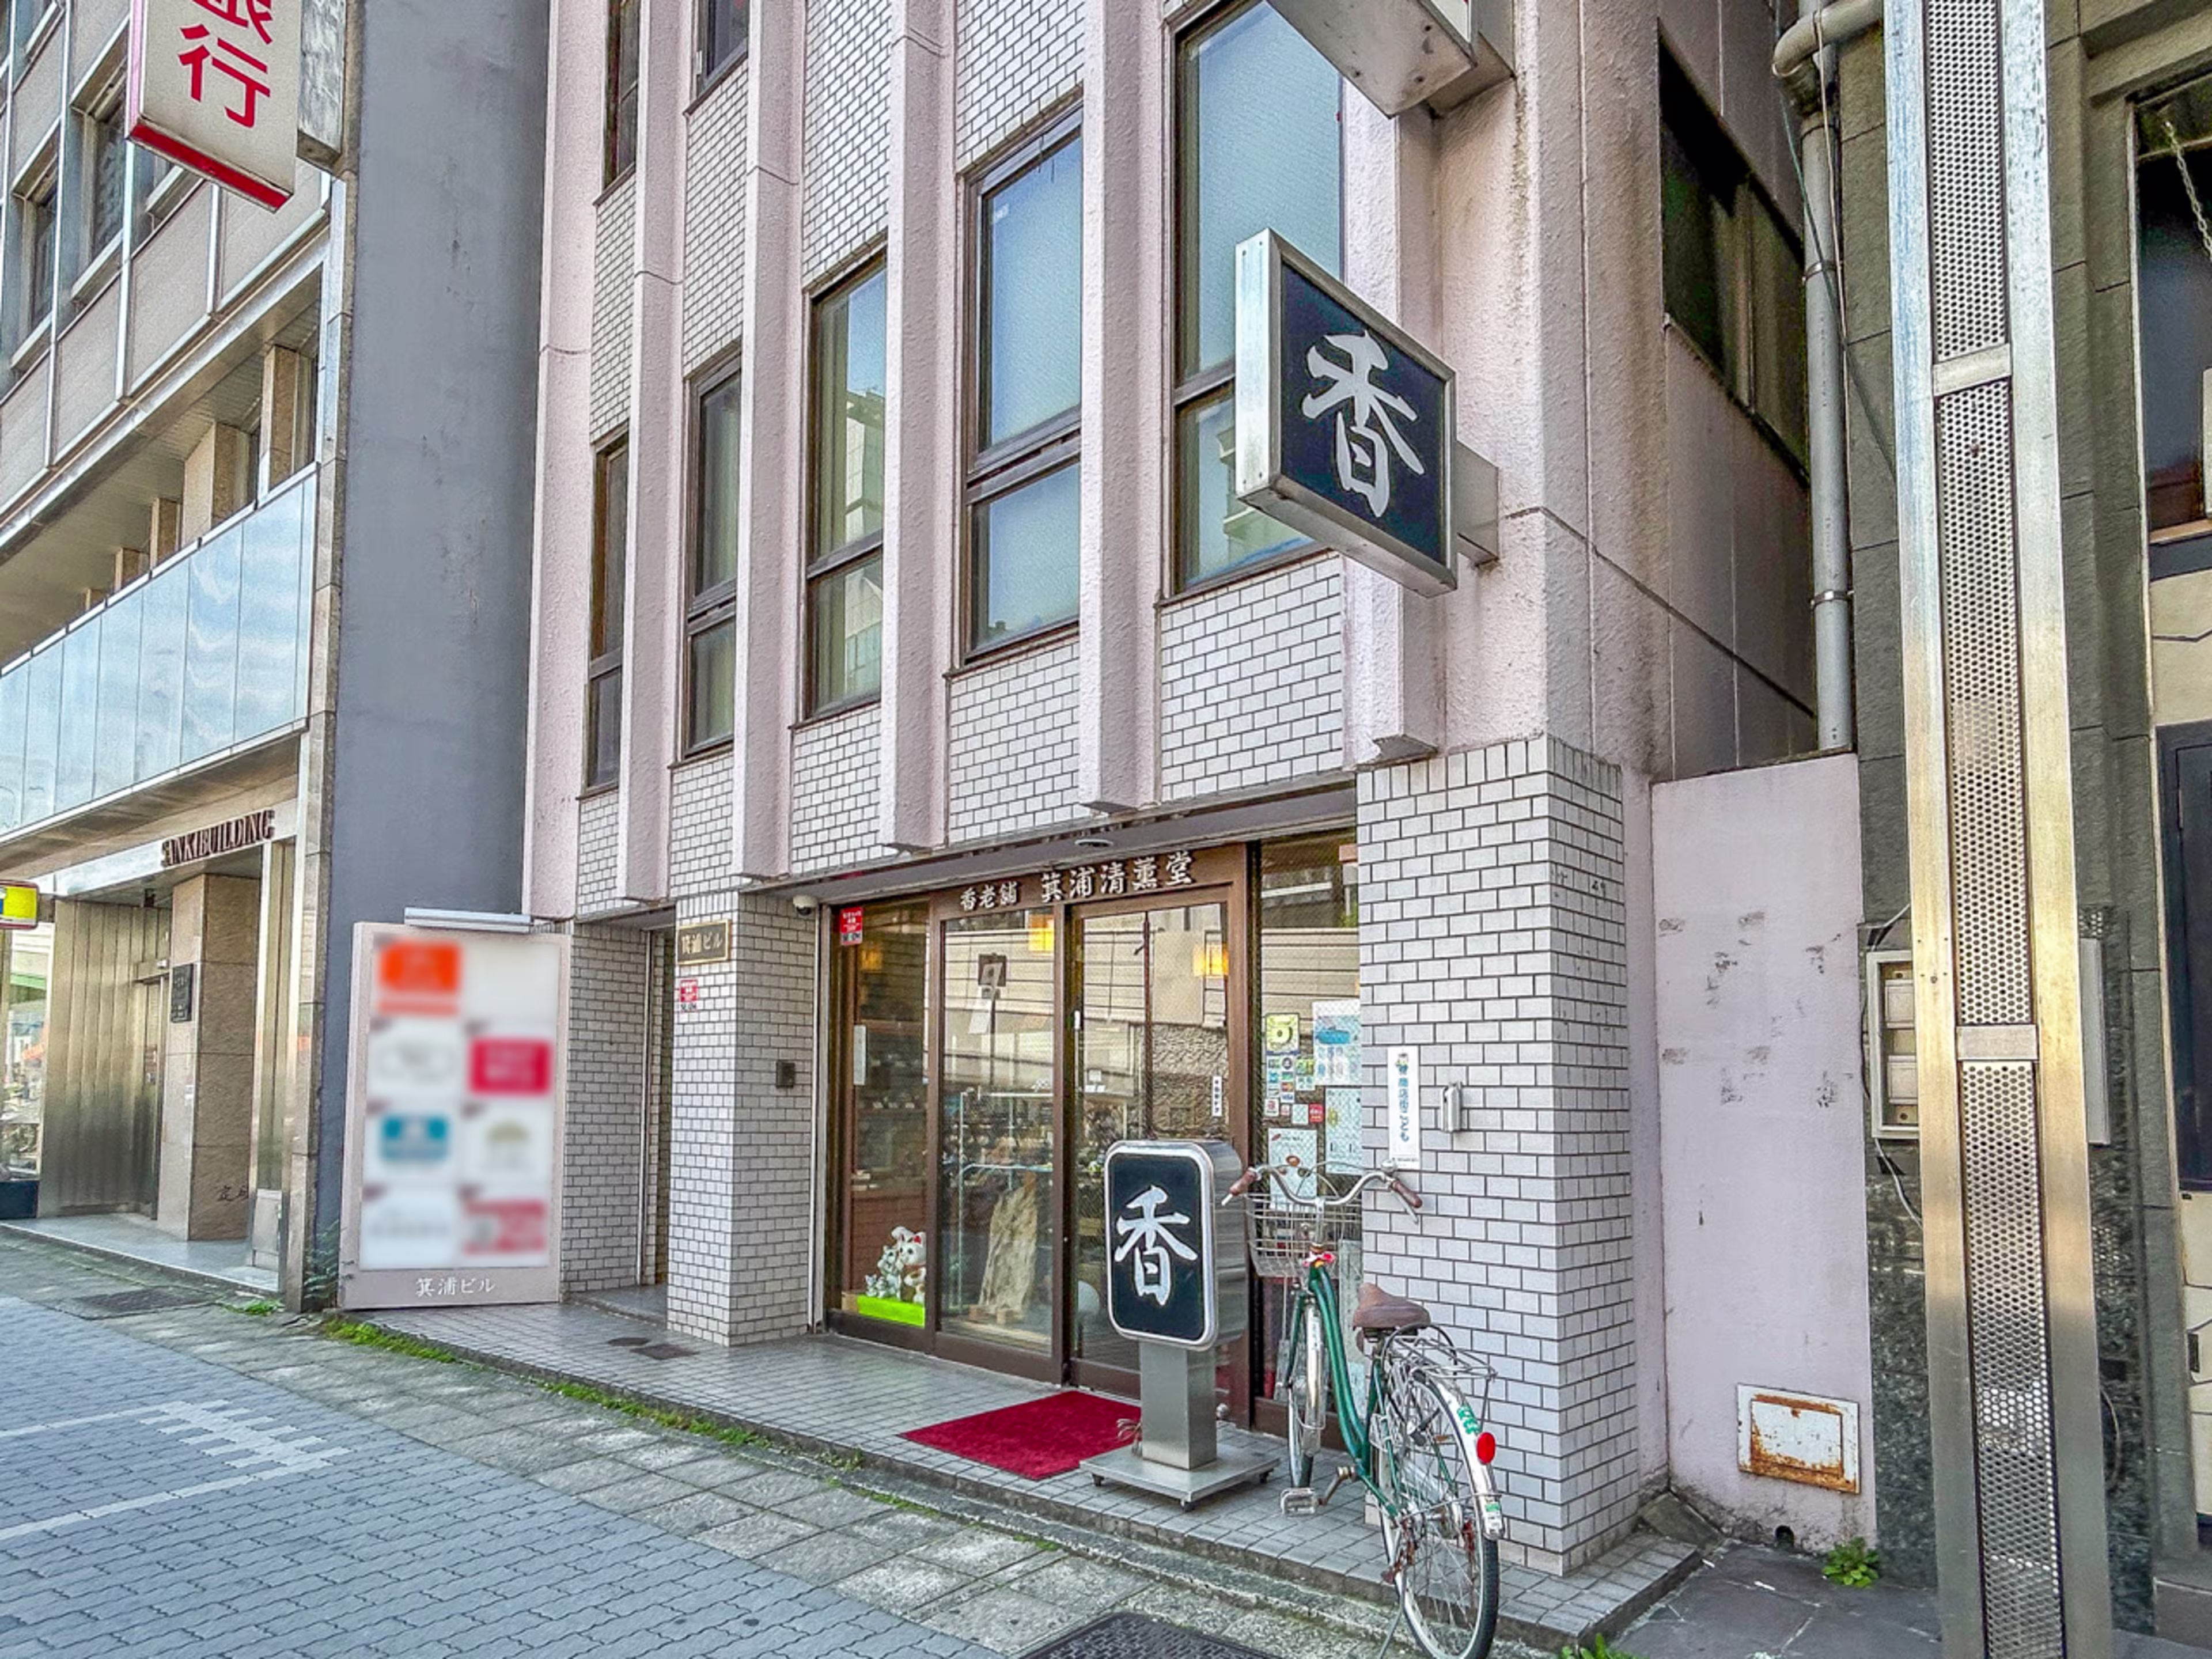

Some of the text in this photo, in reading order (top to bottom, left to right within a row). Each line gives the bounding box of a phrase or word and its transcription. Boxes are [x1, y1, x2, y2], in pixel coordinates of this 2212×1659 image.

[1301, 329, 1425, 517] 香
[960, 880, 1018, 911] 香老舗
[1114, 1184, 1198, 1305] 香
[415, 1277, 496, 1297] 箕浦ビル
